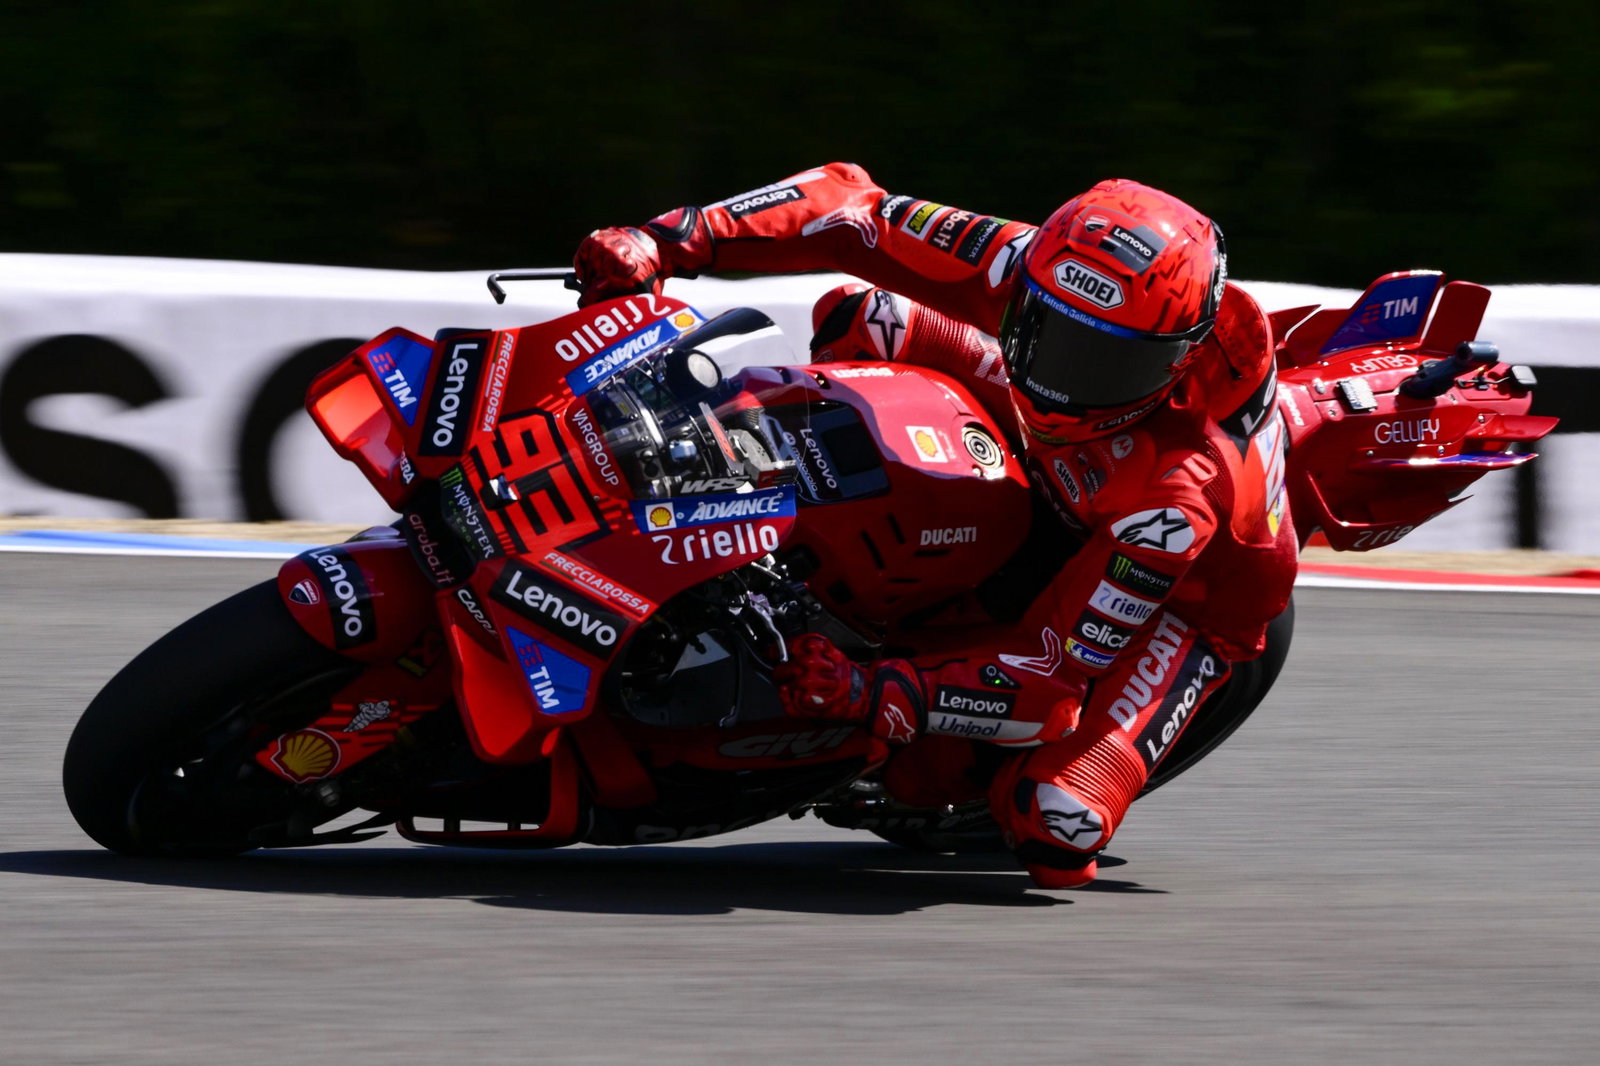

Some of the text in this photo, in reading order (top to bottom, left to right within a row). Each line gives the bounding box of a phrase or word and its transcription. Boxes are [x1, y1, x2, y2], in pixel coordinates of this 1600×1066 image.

[731, 187, 800, 213] Lenovo
[1113, 227, 1152, 257] Lenovo
[1060, 265, 1117, 304] SHOEI
[1043, 294, 1069, 316] Estrella
[1068, 308, 1096, 328] Galicia
[1384, 296, 1419, 319] TIM
[554, 300, 644, 362] riello
[584, 325, 662, 383] ADVANCE
[385, 369, 418, 408] TIM
[432, 343, 479, 447] Lenovo
[482, 332, 514, 433] FRECCIAROSSA
[1025, 376, 1070, 404] Insta360
[573, 408, 620, 487] VARGROUP
[1375, 418, 1440, 444] GELLIFY
[799, 428, 838, 489] Lenovo
[680, 475, 751, 494] WRS
[1056, 462, 1079, 500] SHOEI
[452, 484, 495, 559] MONSTER
[688, 495, 781, 522] ADVANCE
[409, 514, 456, 584] aruba.it
[683, 523, 779, 562] riello
[920, 527, 977, 546] DUCATI
[308, 548, 363, 638] Lenovo
[543, 552, 651, 615] FRECCIAROSSA
[1130, 567, 1170, 588] MONSTER
[505, 569, 617, 647] Lenovo
[1082, 622, 1132, 648] elica
[528, 665, 560, 709] TIM
[1107, 611, 1189, 732] DUCATI
[938, 690, 1008, 714] Lenovo
[1147, 655, 1214, 762] Lenovo
[718, 726, 860, 758] GIVI
[938, 716, 1001, 737] Unipol
